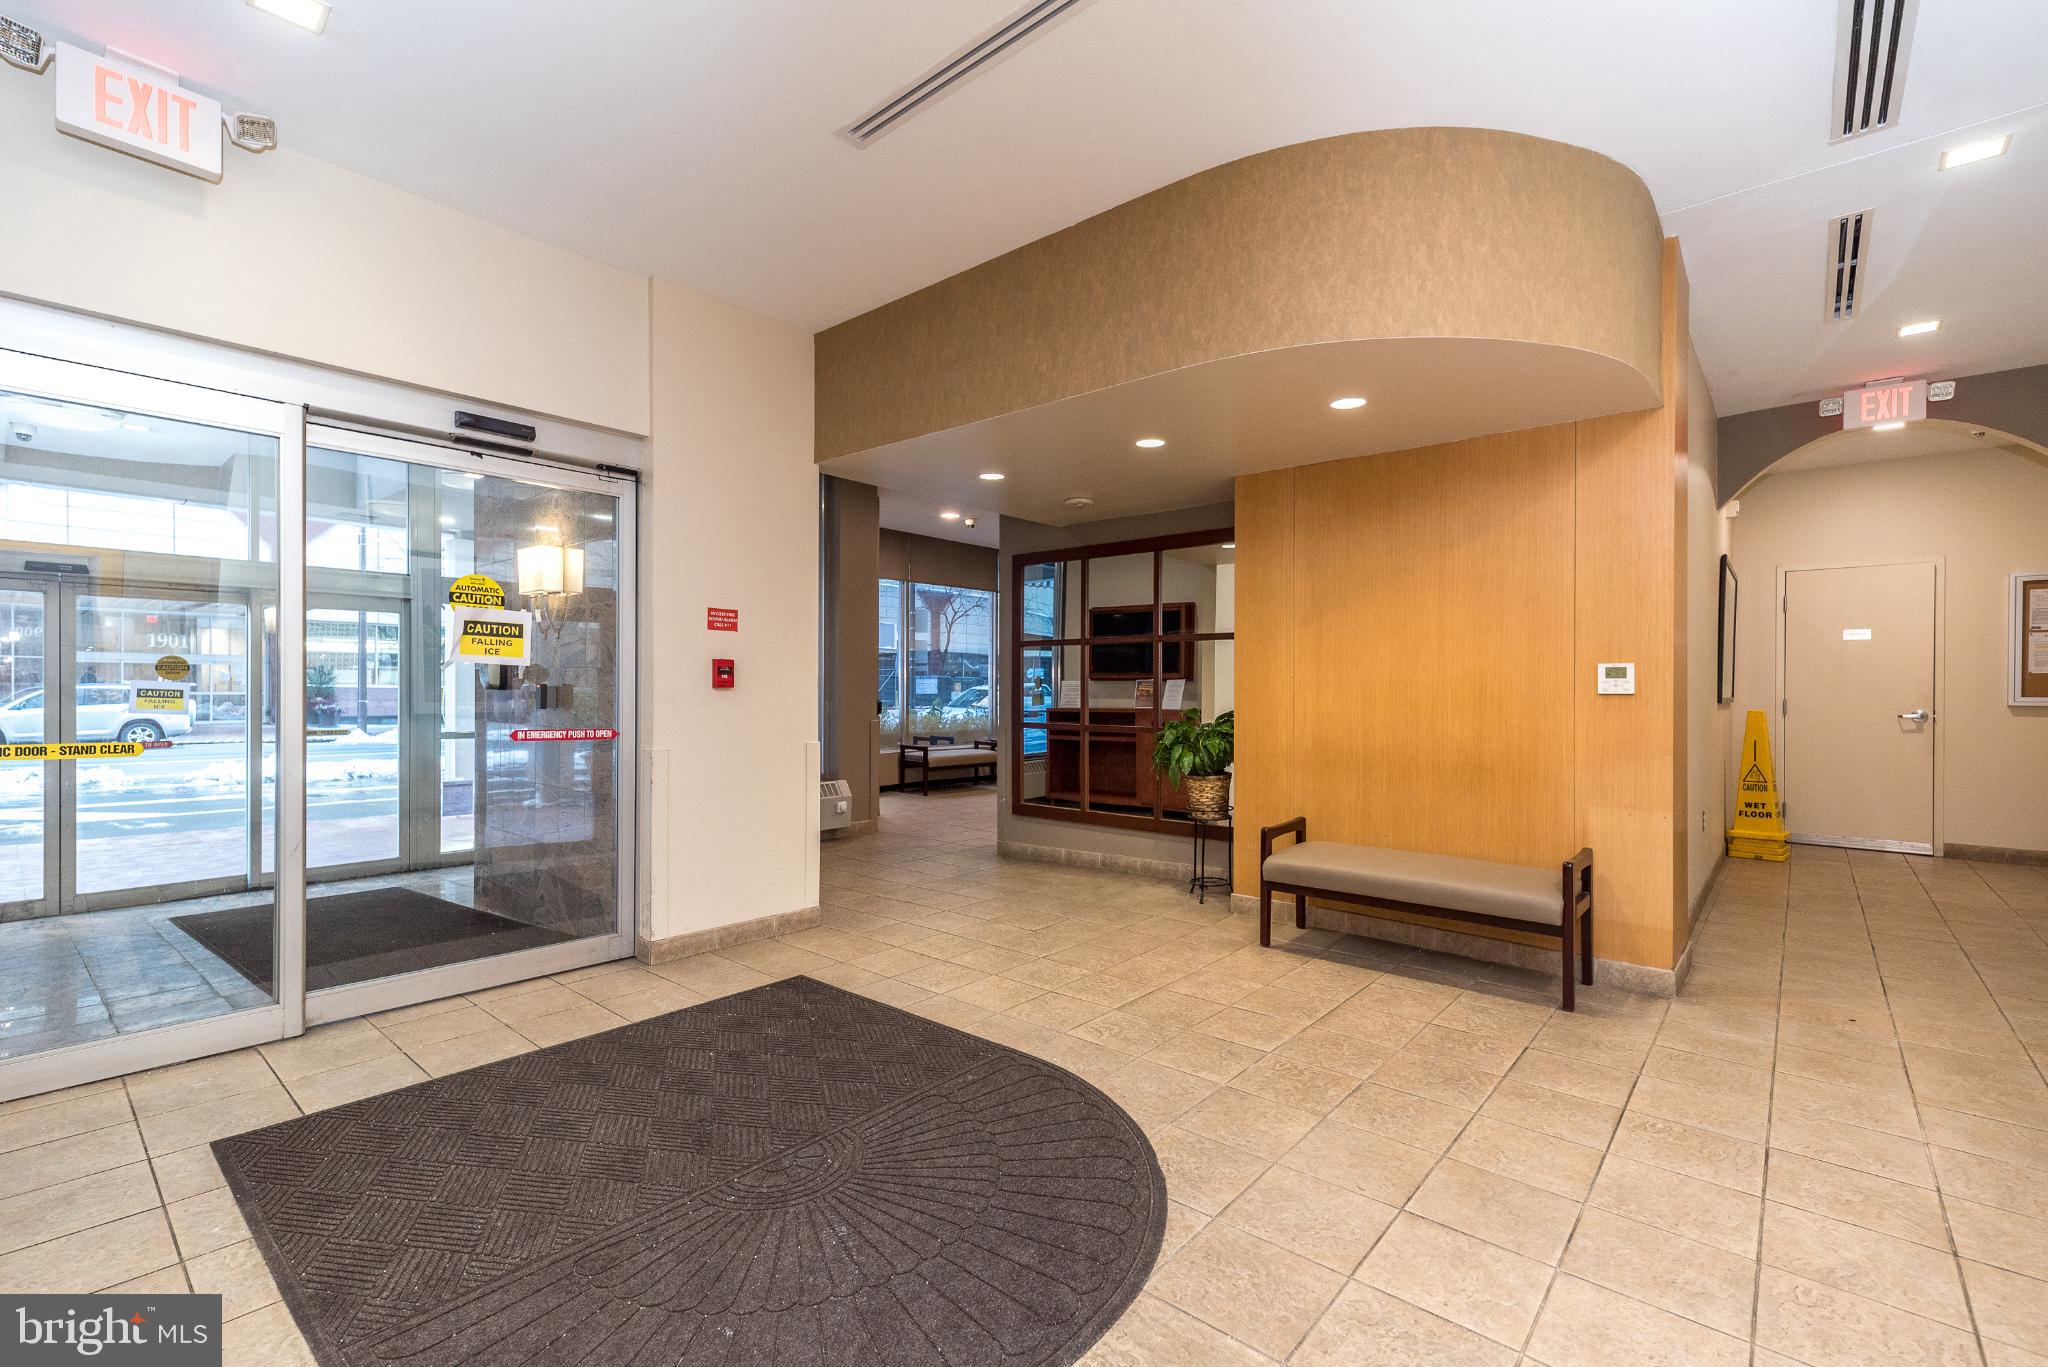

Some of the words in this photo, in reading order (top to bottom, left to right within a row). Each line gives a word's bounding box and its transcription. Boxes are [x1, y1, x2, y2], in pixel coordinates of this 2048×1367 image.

[94, 63, 197, 153] EXIT
[1860, 386, 1914, 422] EXIT
[455, 584, 500, 594] AUTOMATIC
[452, 592, 502, 606] CAUTION
[466, 623, 519, 636] CAUTION
[148, 633, 189, 649] 1901
[471, 637, 513, 647] FALLING
[484, 648, 500, 656] ICE
[140, 689, 181, 698] CAUTION
[517, 731, 525, 739] IN
[526, 730, 566, 739] EMERGENCY
[567, 730, 585, 738] PUSH
[586, 730, 595, 738] TO
[595, 729, 612, 738] OPEN
[14, 746, 48, 757] DOOR
[59, 745, 97, 756] STAND
[99, 744, 135, 754] CLEAR
[1742, 783, 1768, 793] CAUTION
[1744, 801, 1767, 809] WET
[1738, 810, 1772, 819] FLOOR
